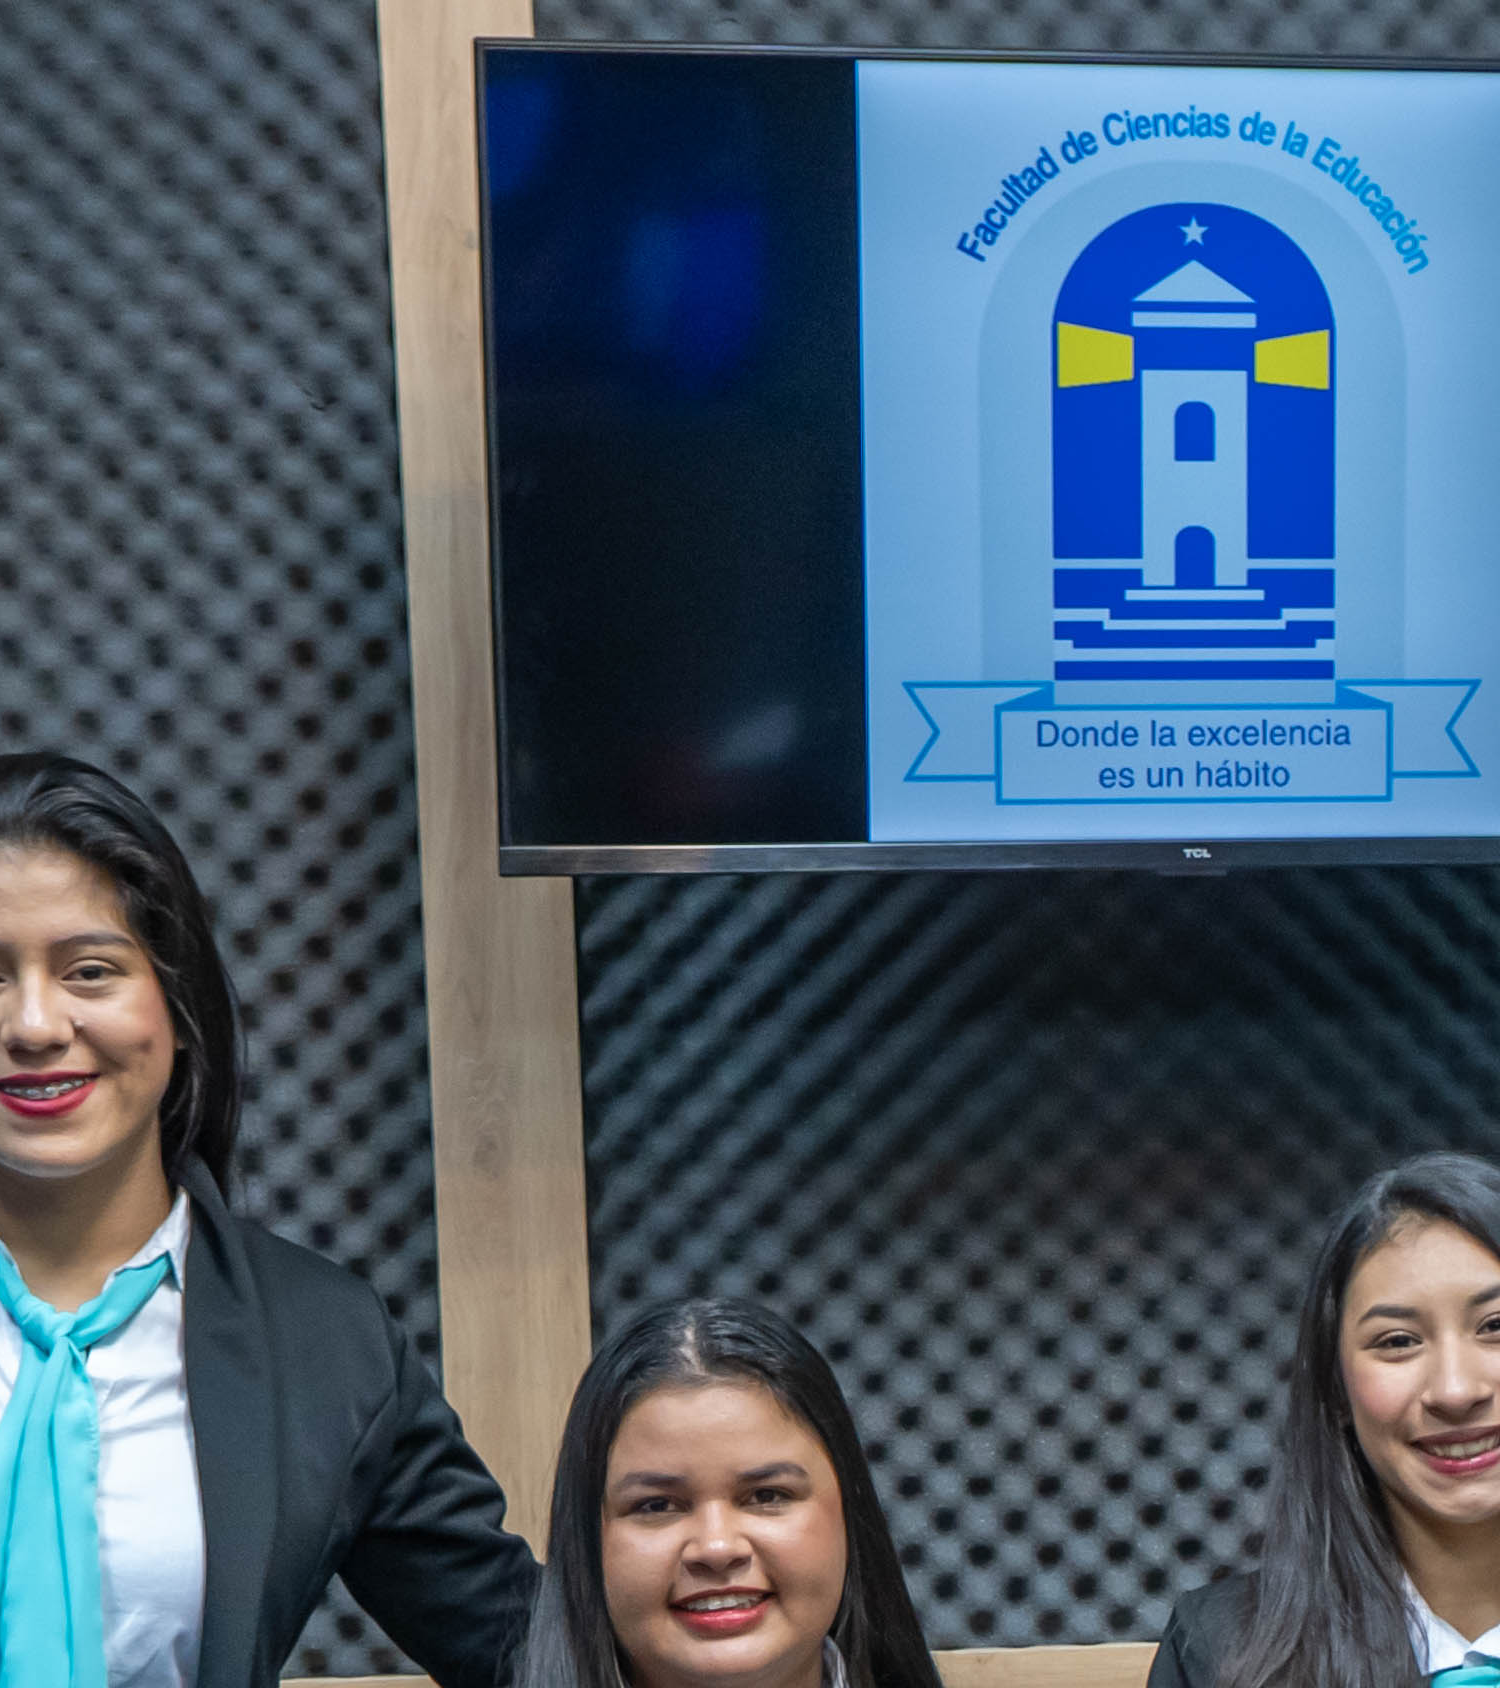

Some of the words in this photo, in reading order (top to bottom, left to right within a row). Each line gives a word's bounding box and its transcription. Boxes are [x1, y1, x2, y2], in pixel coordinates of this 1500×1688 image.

[956, 146, 1060, 262] Facultad
[1060, 130, 1099, 165] de
[1102, 104, 1231, 146] Ciencias
[1238, 111, 1277, 146] de
[1281, 120, 1309, 158] la
[1311, 136, 1429, 275] Educación
[1036, 719, 1139, 748] Donde
[1151, 719, 1177, 747] la
[1187, 718, 1351, 747] excelencia
[1098, 766, 1135, 789] es
[1146, 766, 1184, 788] un
[1196, 760, 1291, 788] hábito
[1182, 848, 1212, 859] TCL
